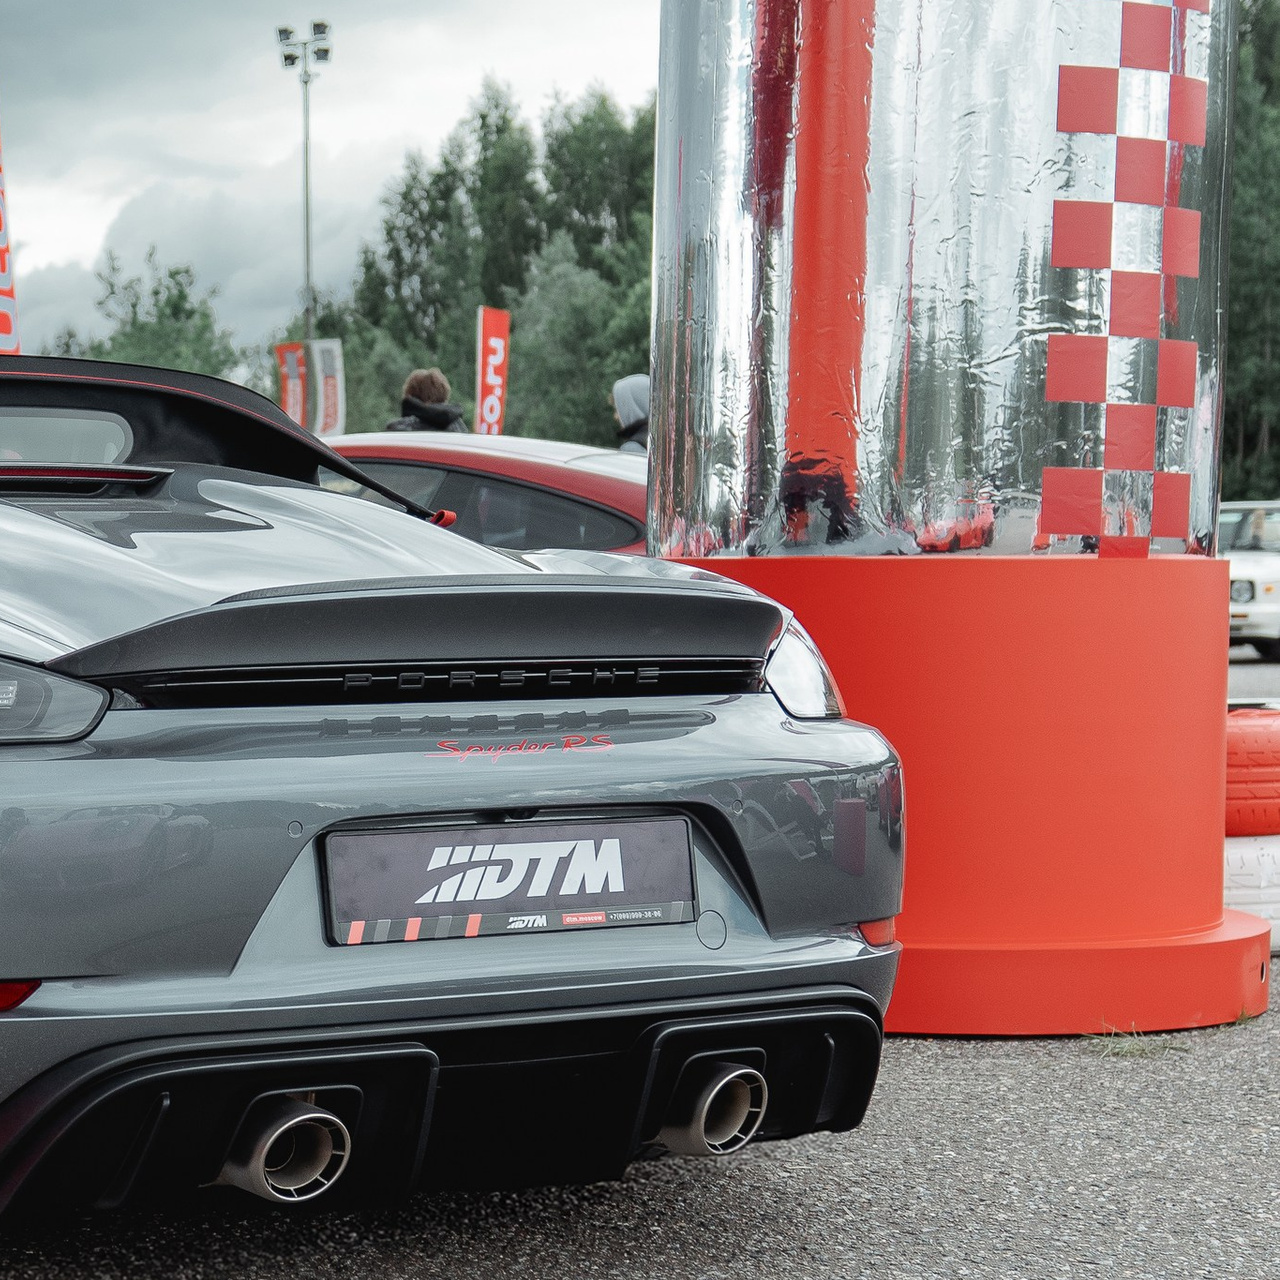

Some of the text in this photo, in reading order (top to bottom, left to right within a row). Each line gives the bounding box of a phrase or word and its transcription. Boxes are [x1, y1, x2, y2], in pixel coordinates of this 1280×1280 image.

[344, 667, 660, 691] PORSCHE
[424, 734, 615, 763] Spyder RS
